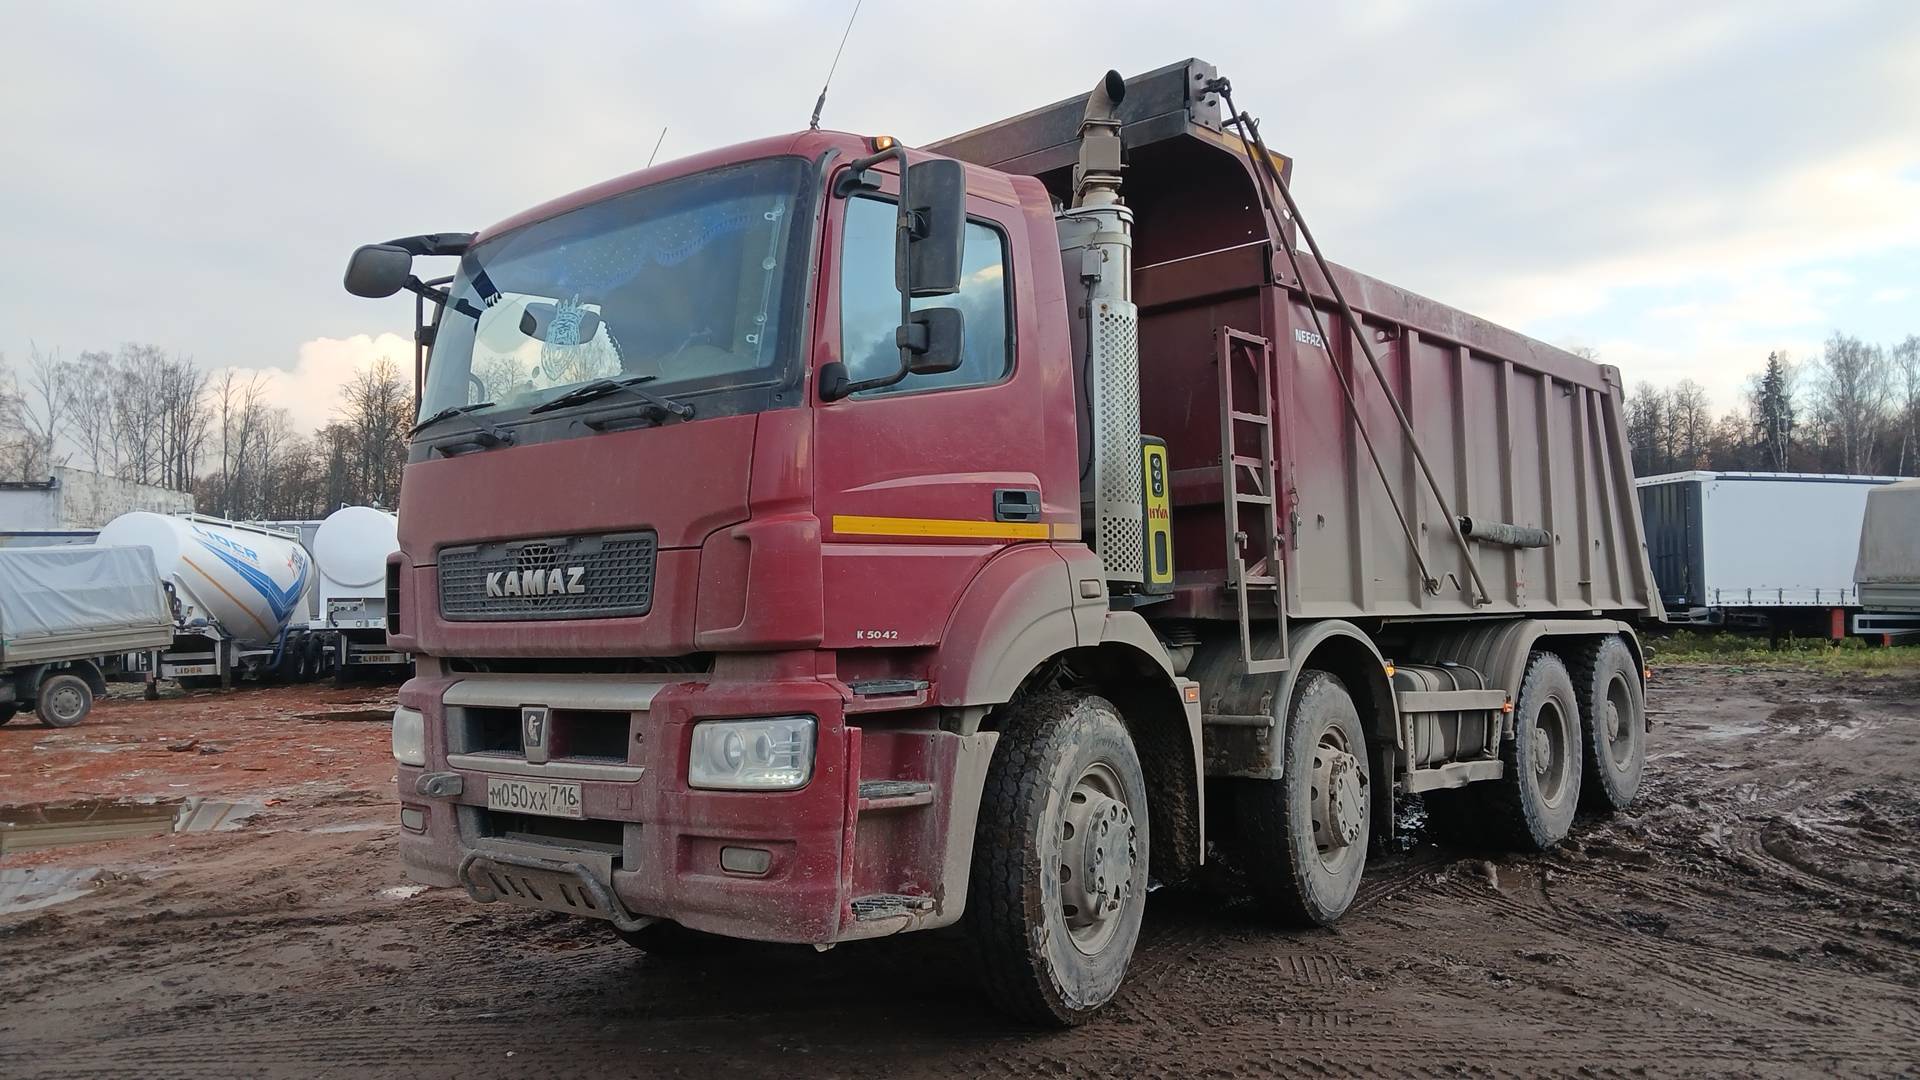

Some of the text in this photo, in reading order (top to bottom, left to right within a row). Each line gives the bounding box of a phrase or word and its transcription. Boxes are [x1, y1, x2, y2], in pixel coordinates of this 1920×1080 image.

[1295, 328, 1321, 347] NEFAZ
[1149, 503, 1168, 519] HYVA
[486, 566, 585, 598] KAMAZ
[856, 630, 898, 639] K 5042
